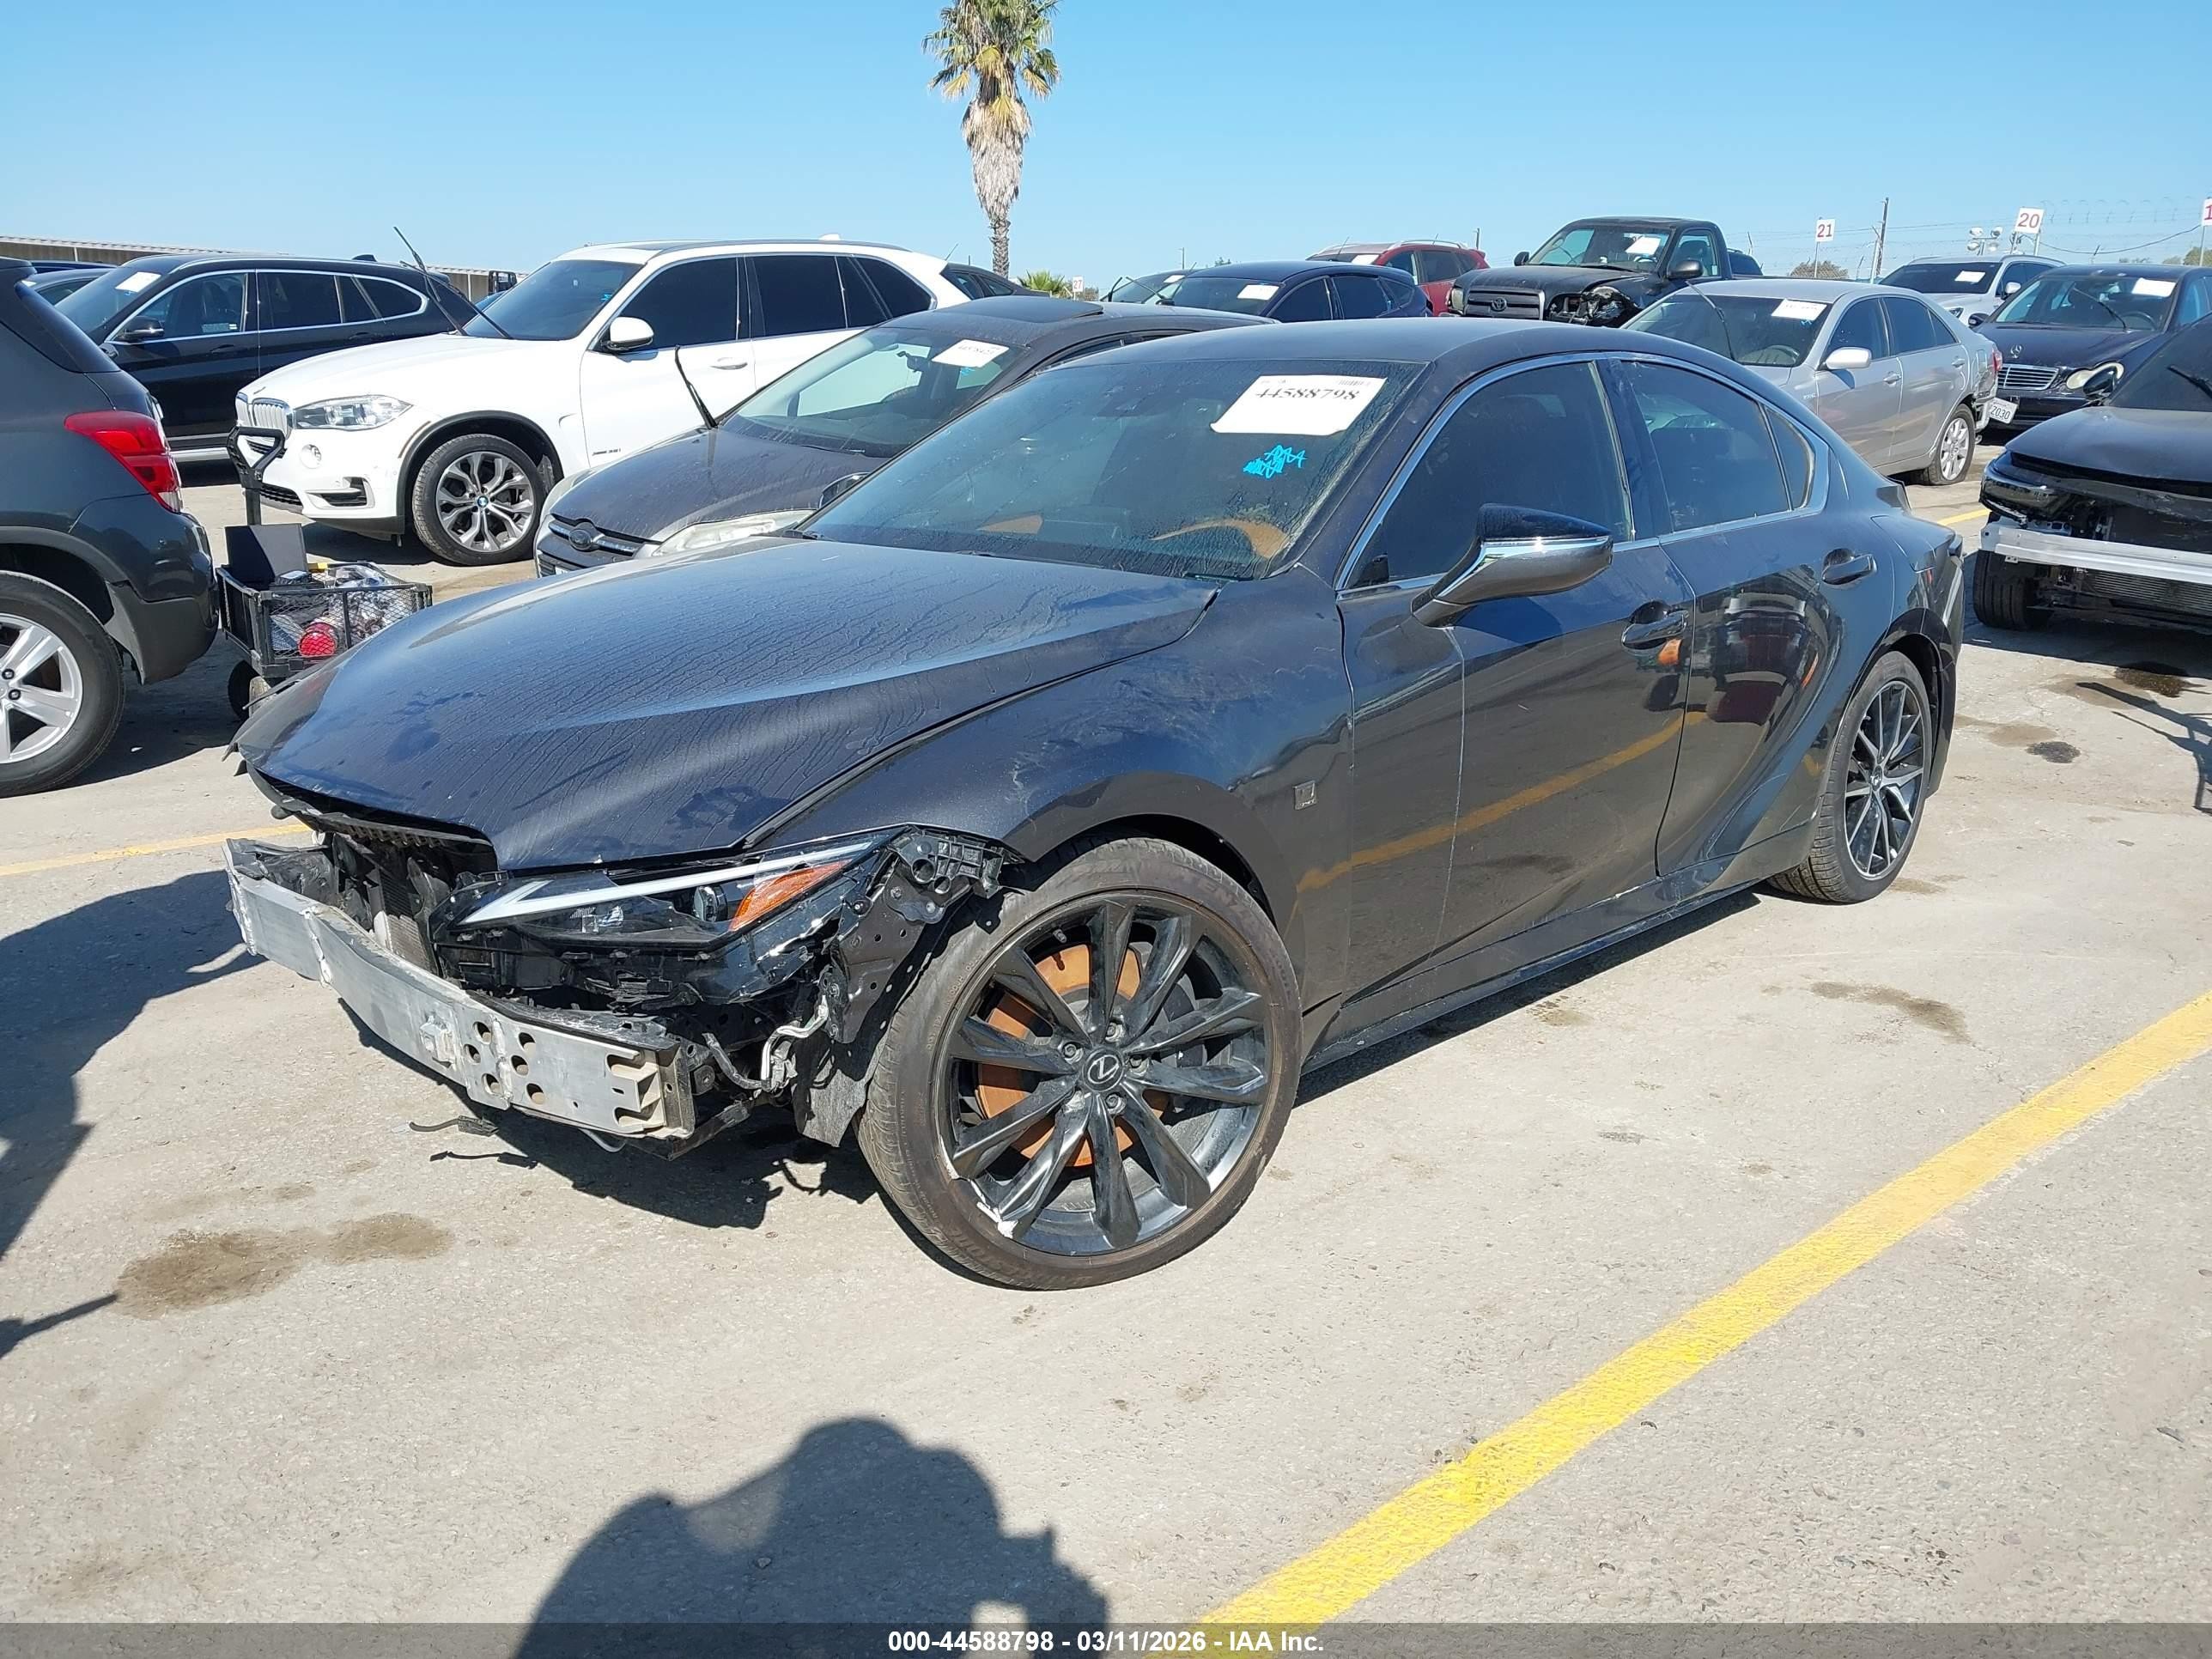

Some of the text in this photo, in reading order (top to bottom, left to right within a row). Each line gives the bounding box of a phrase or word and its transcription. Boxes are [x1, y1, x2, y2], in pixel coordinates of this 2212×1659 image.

[2204, 204, 2212, 220] 1
[2018, 212, 2039, 228] 20
[1817, 223, 1832, 238] 21
[1073, 279, 1082, 289] 27
[1255, 387, 1359, 400] 44588798
